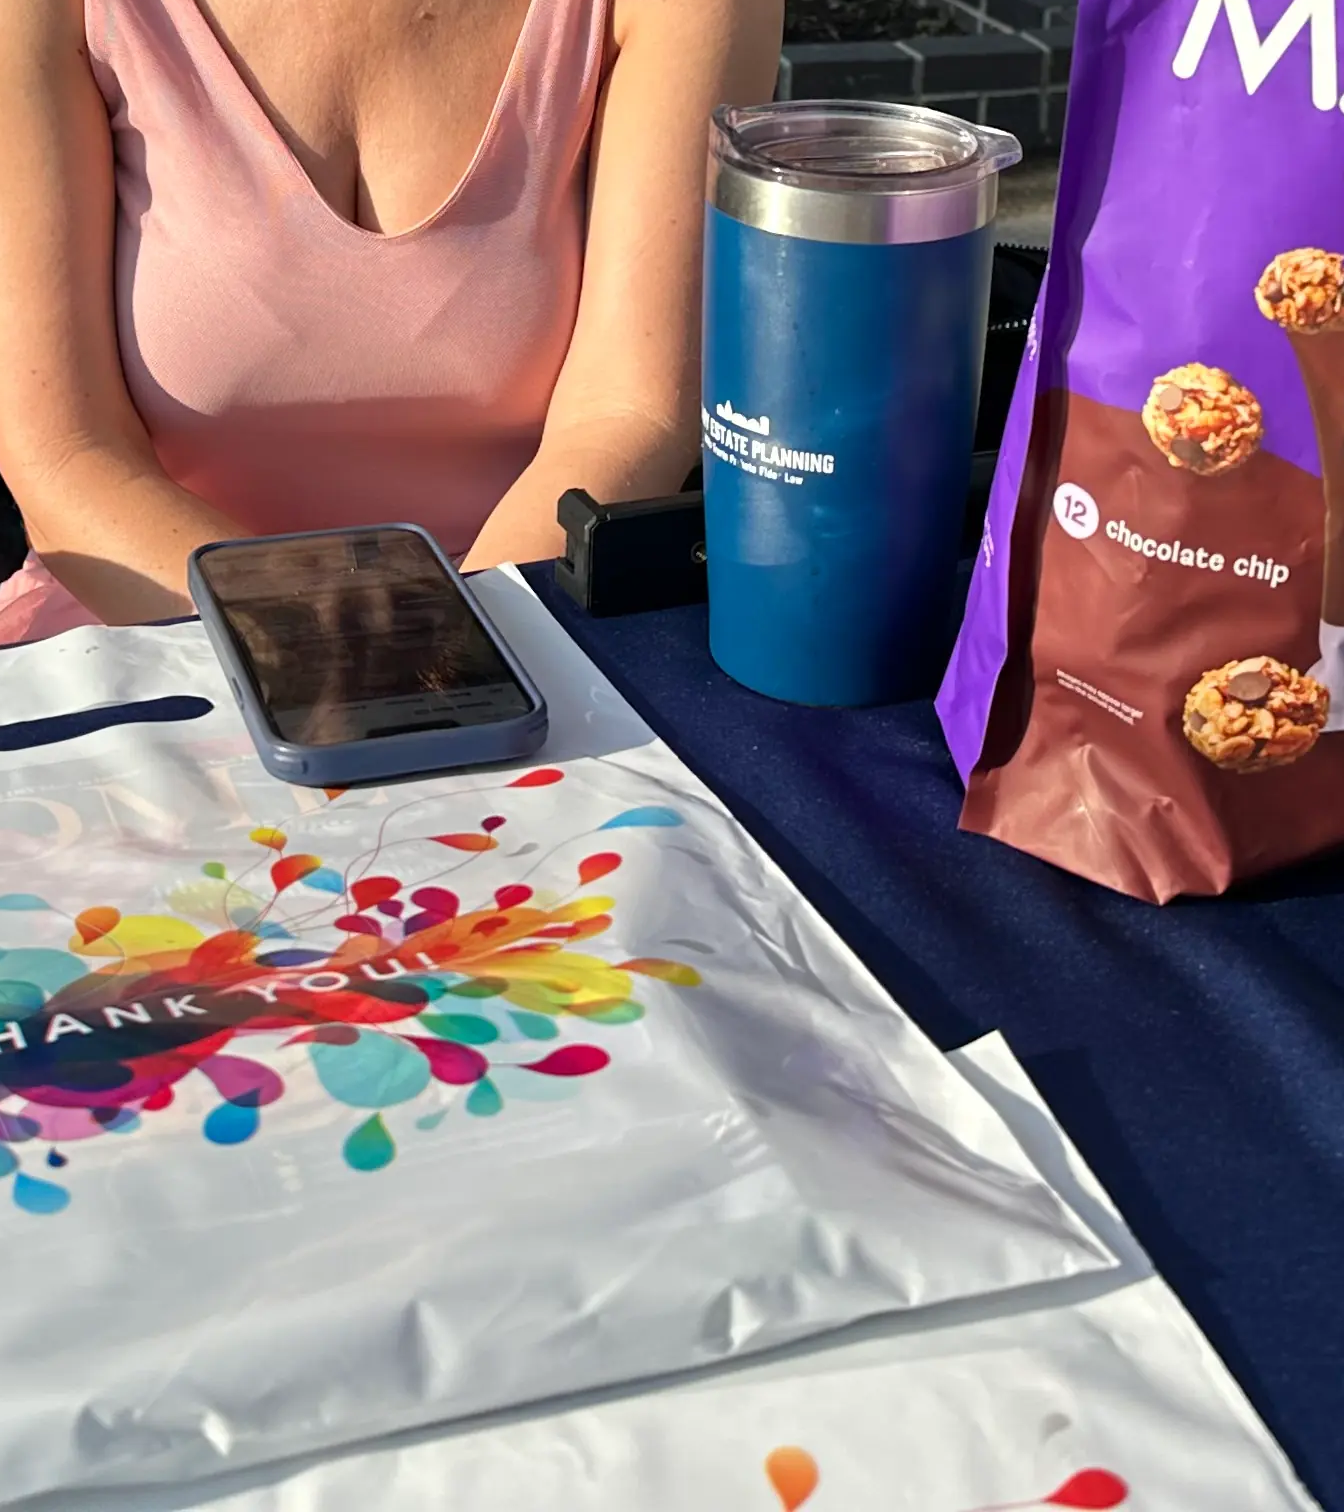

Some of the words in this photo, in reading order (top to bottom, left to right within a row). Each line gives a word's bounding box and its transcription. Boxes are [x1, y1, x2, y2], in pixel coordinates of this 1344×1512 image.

[751, 439, 835, 475] PLANNING
[1063, 495, 1087, 528] 12
[1105, 519, 1225, 572] chocolate
[1233, 555, 1290, 589] chip
[245, 951, 441, 1004] YOU!
